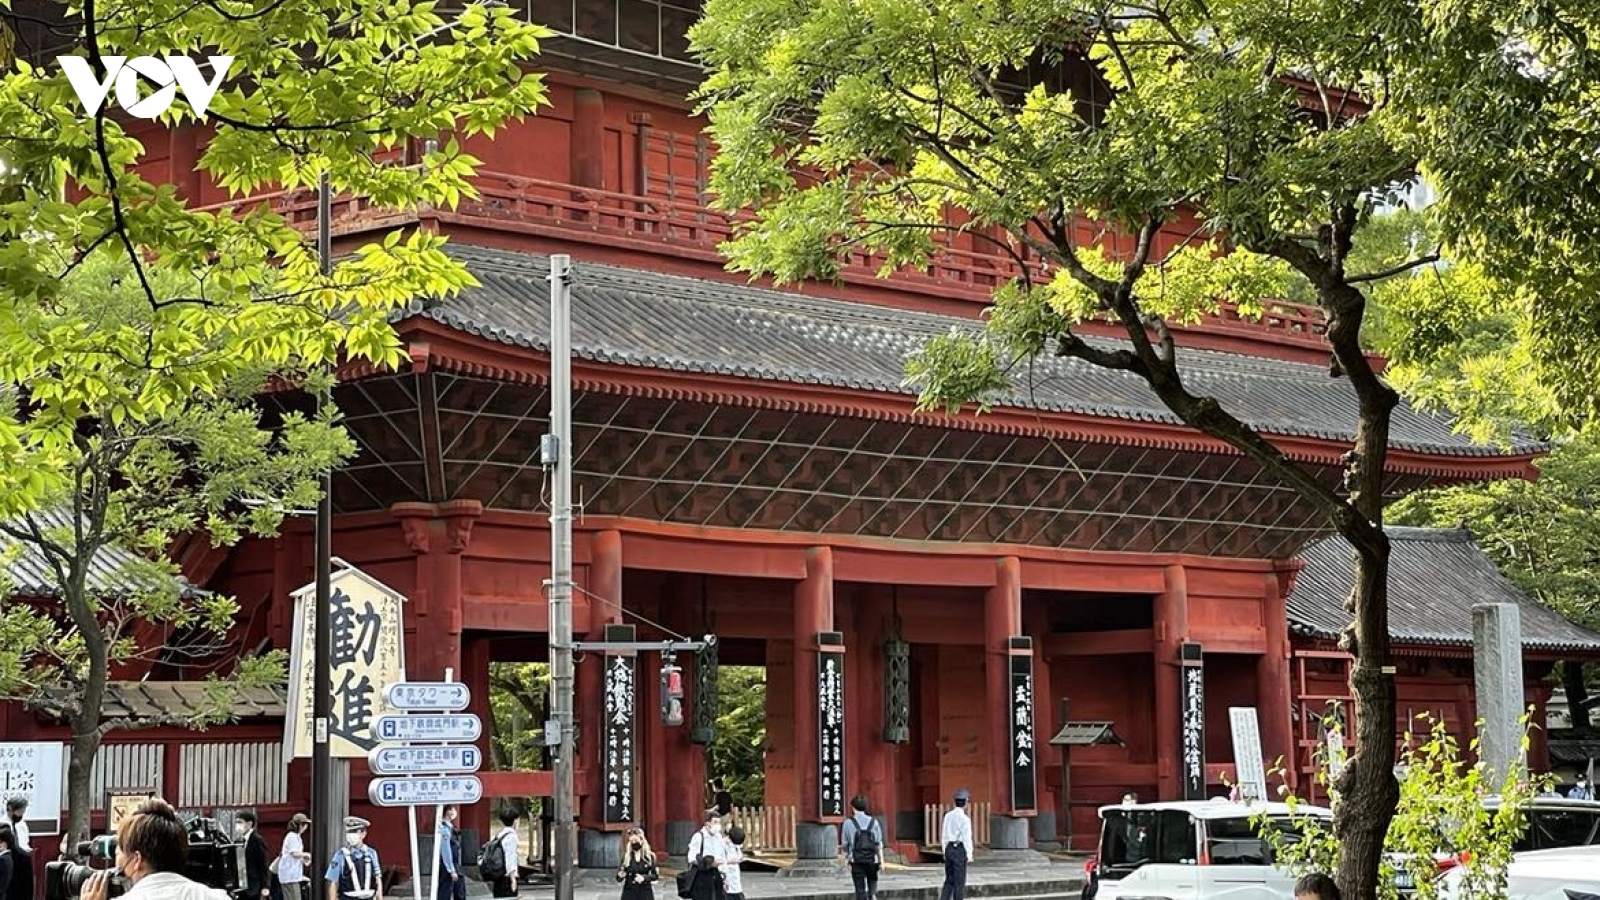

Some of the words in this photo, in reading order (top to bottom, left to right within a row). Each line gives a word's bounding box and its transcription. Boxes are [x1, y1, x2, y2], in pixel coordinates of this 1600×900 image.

[396, 687, 447, 698] 東京タワー
[400, 780, 460, 792] 地下鉄大門駅
